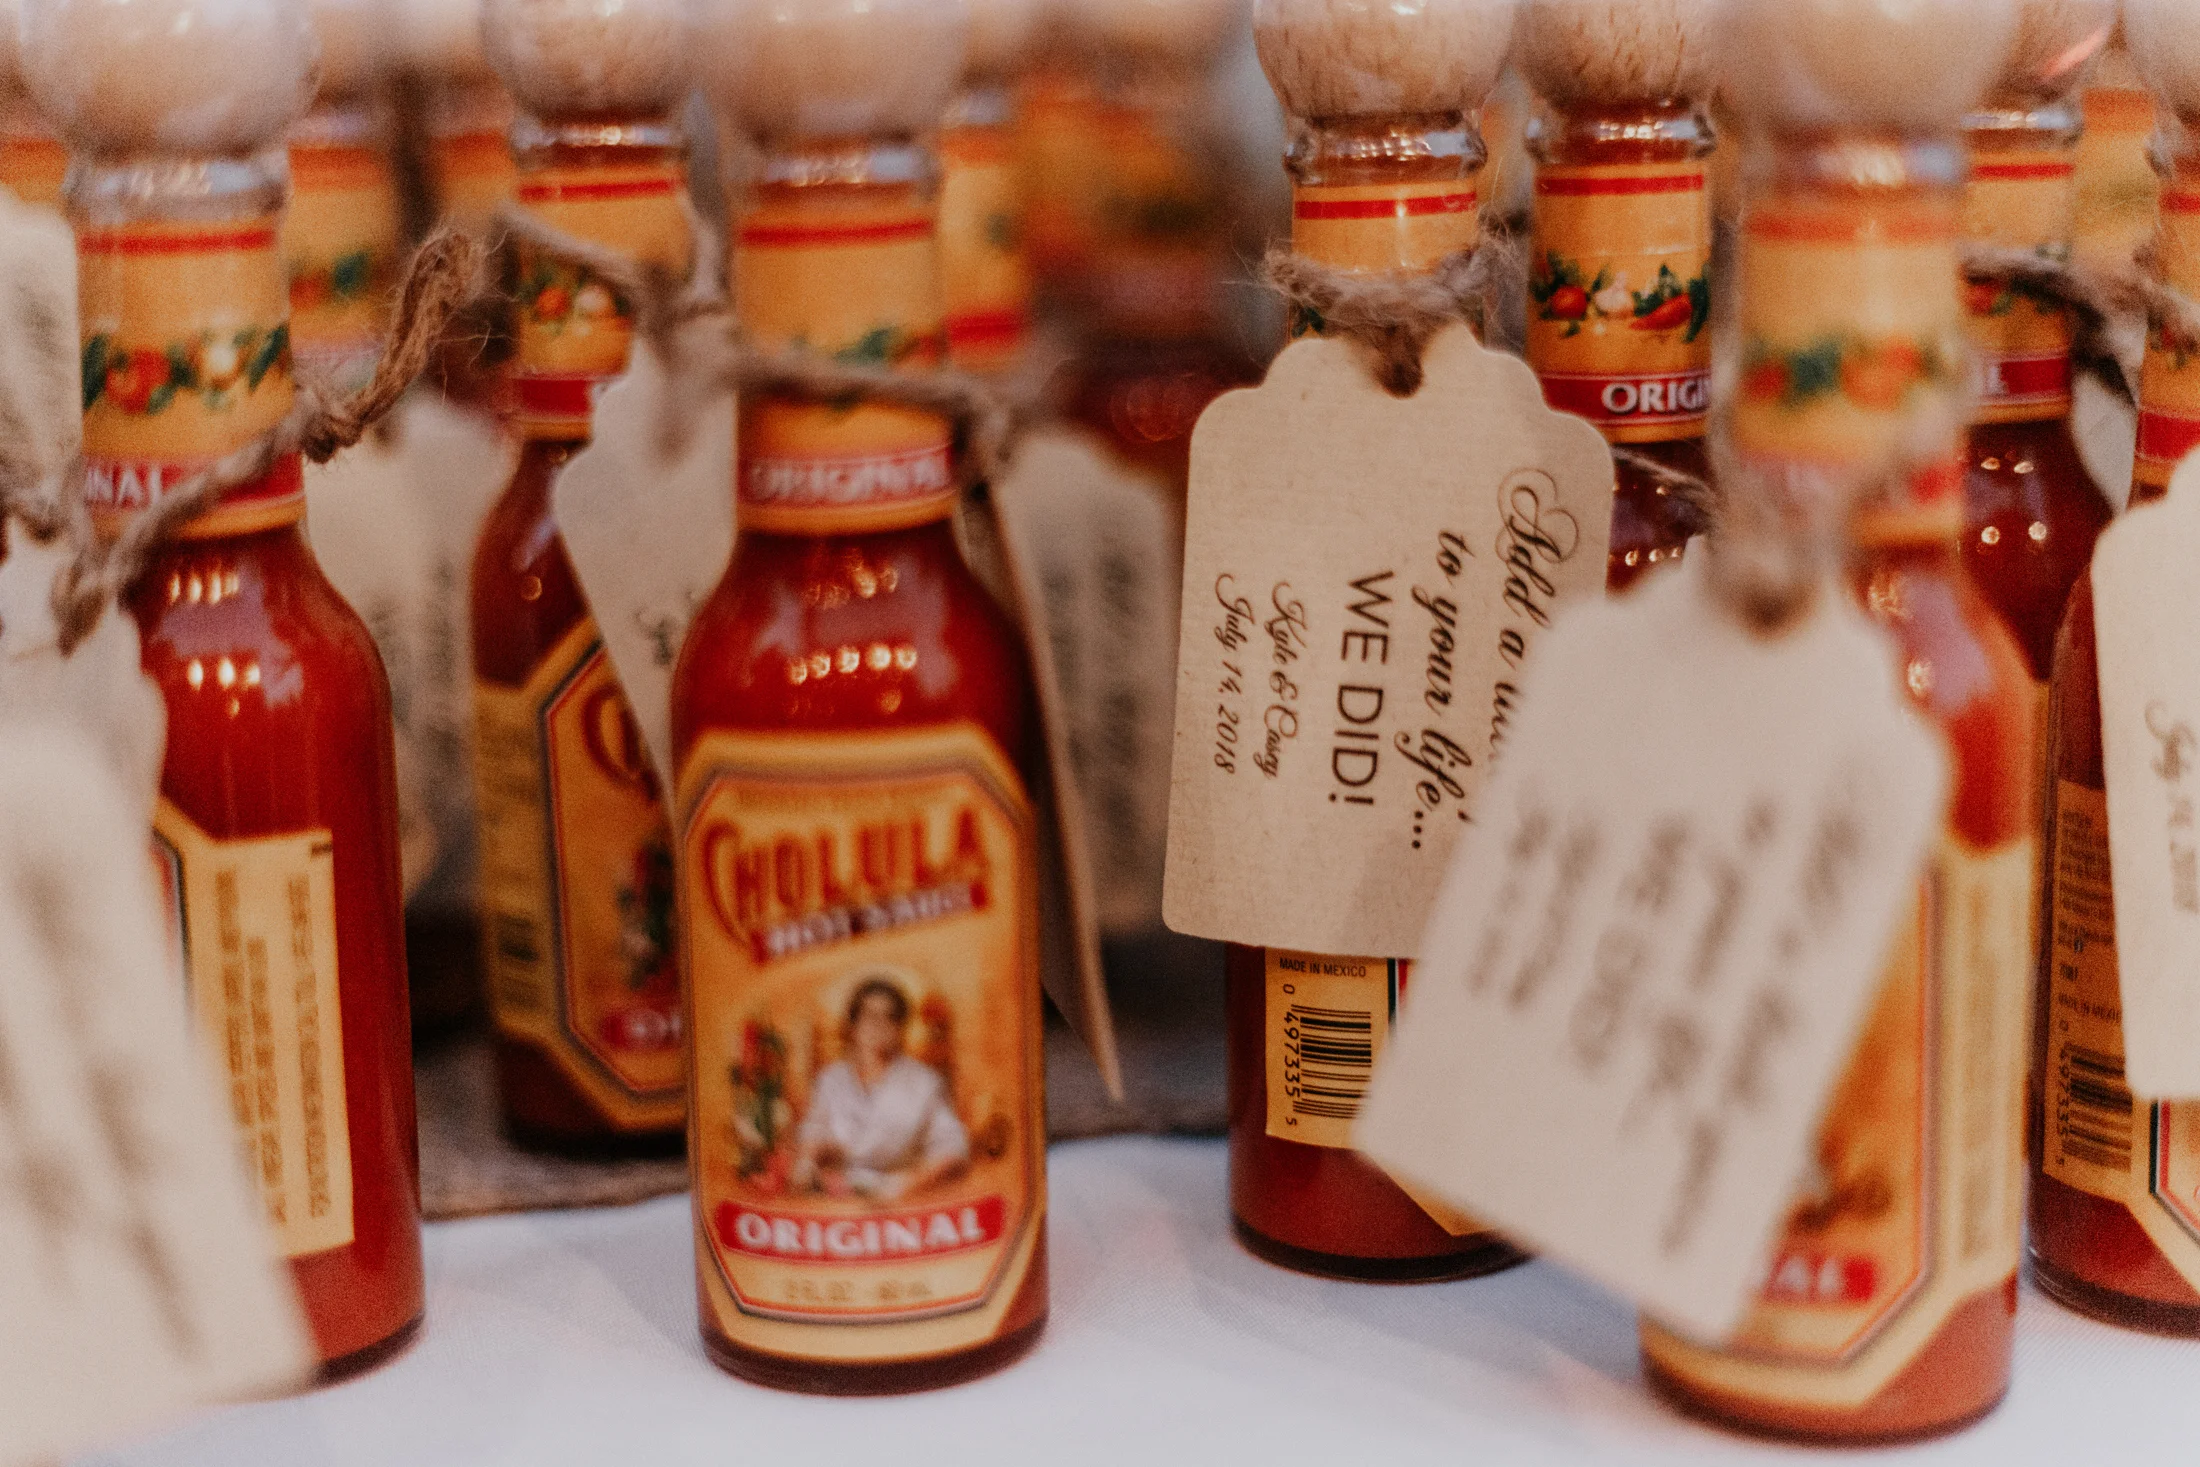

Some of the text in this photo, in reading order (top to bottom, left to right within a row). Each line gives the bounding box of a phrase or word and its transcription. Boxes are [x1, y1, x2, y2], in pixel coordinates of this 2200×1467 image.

[1435, 529, 1476, 585] to
[1496, 466, 1580, 628] Add
[1213, 572, 1257, 656] July
[1263, 581, 1308, 668] Kyle
[1410, 583, 1460, 716] your
[1498, 626, 1527, 672] a
[1326, 568, 1396, 806] WE DID!
[1213, 703, 1241, 775] 2018
[1280, 957, 1367, 978] MADE IN MEXICO
[1283, 983, 1296, 995] 0
[1284, 1011, 1301, 1098] 497335
[1286, 1116, 1298, 1127] 5
[735, 1205, 988, 1258] ORIGINAL
